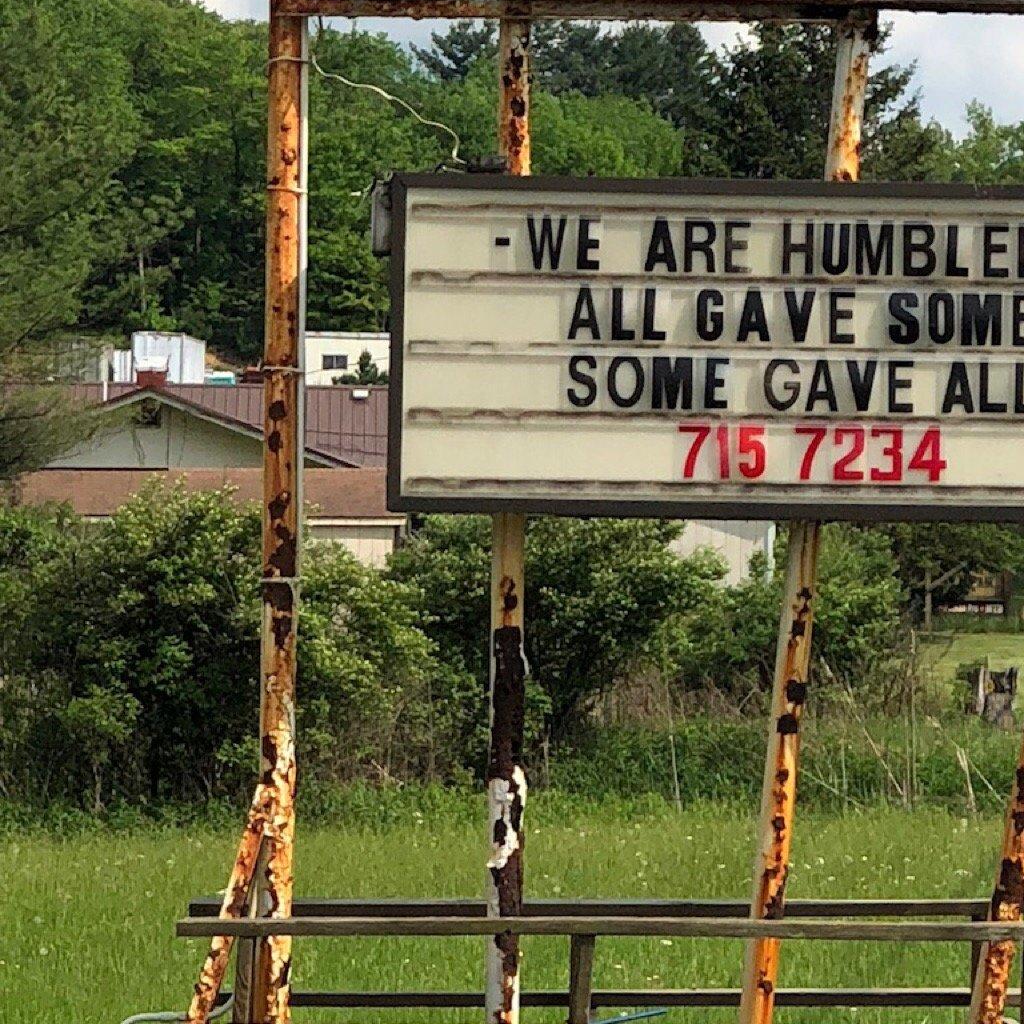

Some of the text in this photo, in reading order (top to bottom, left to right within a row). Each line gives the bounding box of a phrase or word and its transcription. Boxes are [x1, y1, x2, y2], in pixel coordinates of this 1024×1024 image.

[527, 216, 600, 270] WE
[645, 218, 751, 273] ARE
[567, 287, 665, 341] ALL
[696, 288, 854, 344] GAVE
[568, 356, 728, 410] SOME
[764, 358, 912, 413] GAVE
[678, 424, 947, 481] 715 7234
